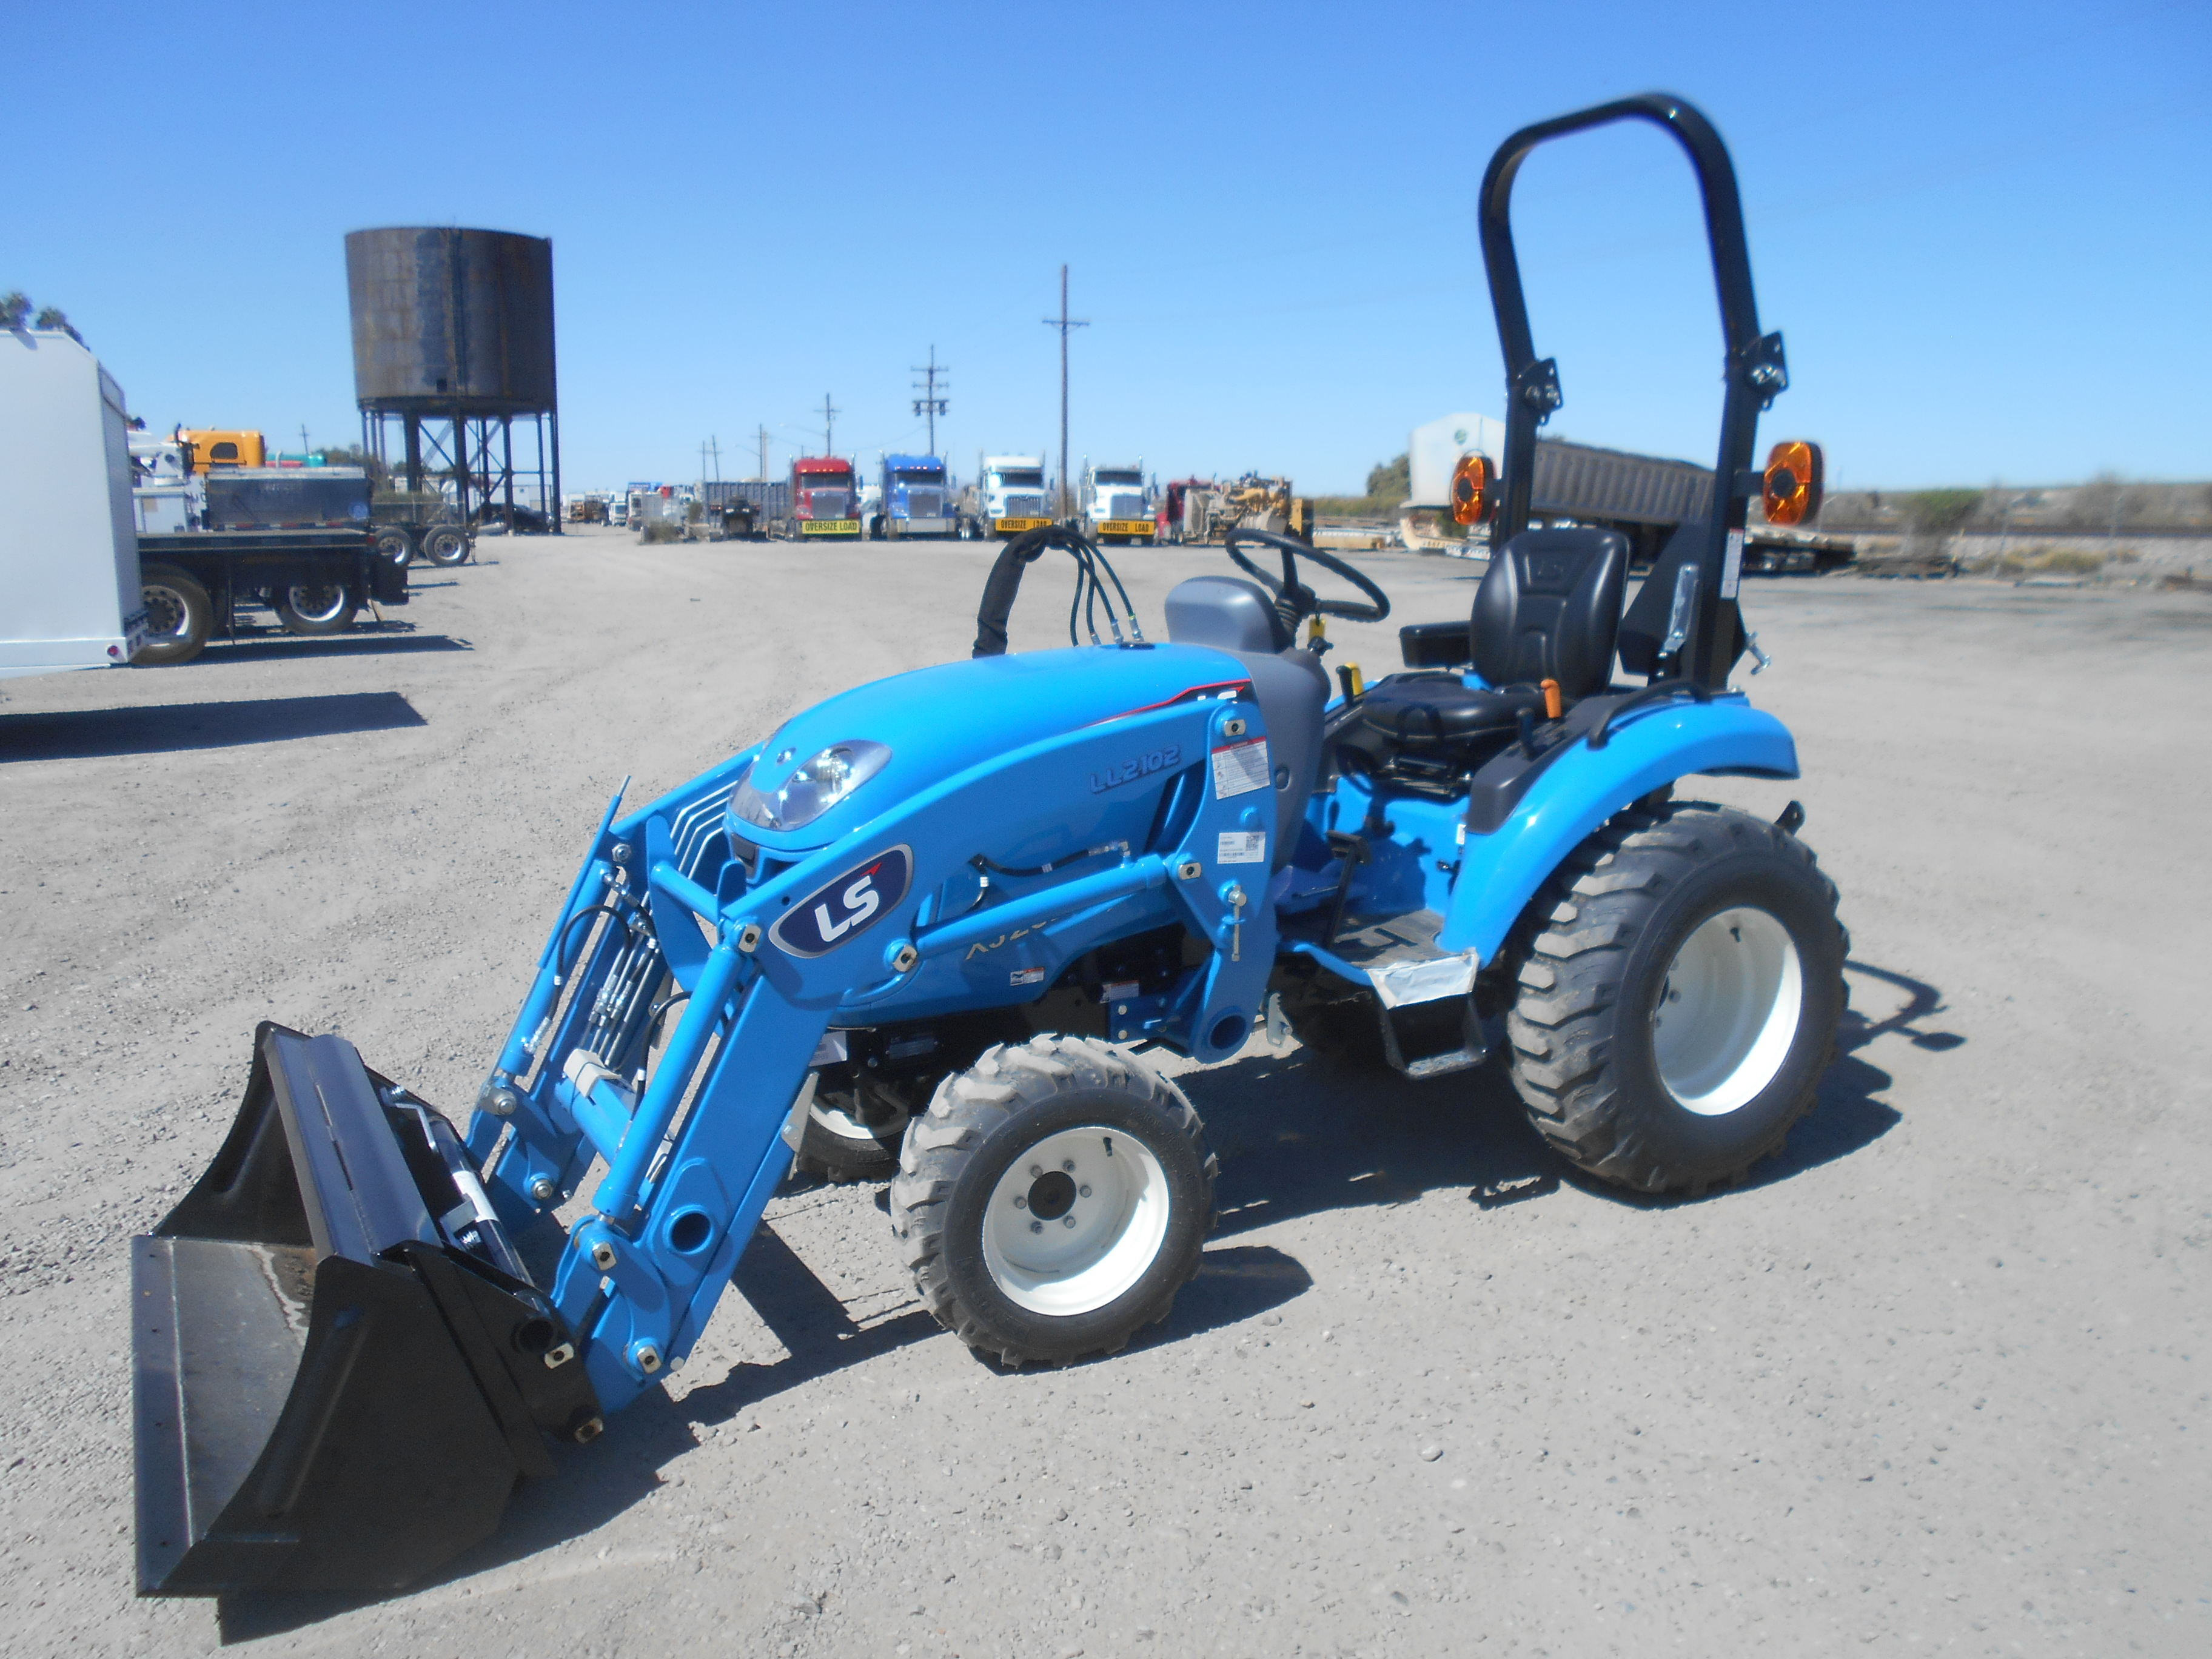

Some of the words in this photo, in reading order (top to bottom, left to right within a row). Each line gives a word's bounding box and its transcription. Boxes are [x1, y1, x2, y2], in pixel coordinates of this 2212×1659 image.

[805, 522, 837, 531] OVERSIZE
[840, 521, 857, 531] LOAD
[1001, 520, 1027, 529] OVERSIZE
[1102, 522, 1128, 531] OVERSIZE
[1135, 523, 1149, 532] LOAD
[1090, 745, 1181, 794] LL2102
[814, 875, 879, 942] LS
